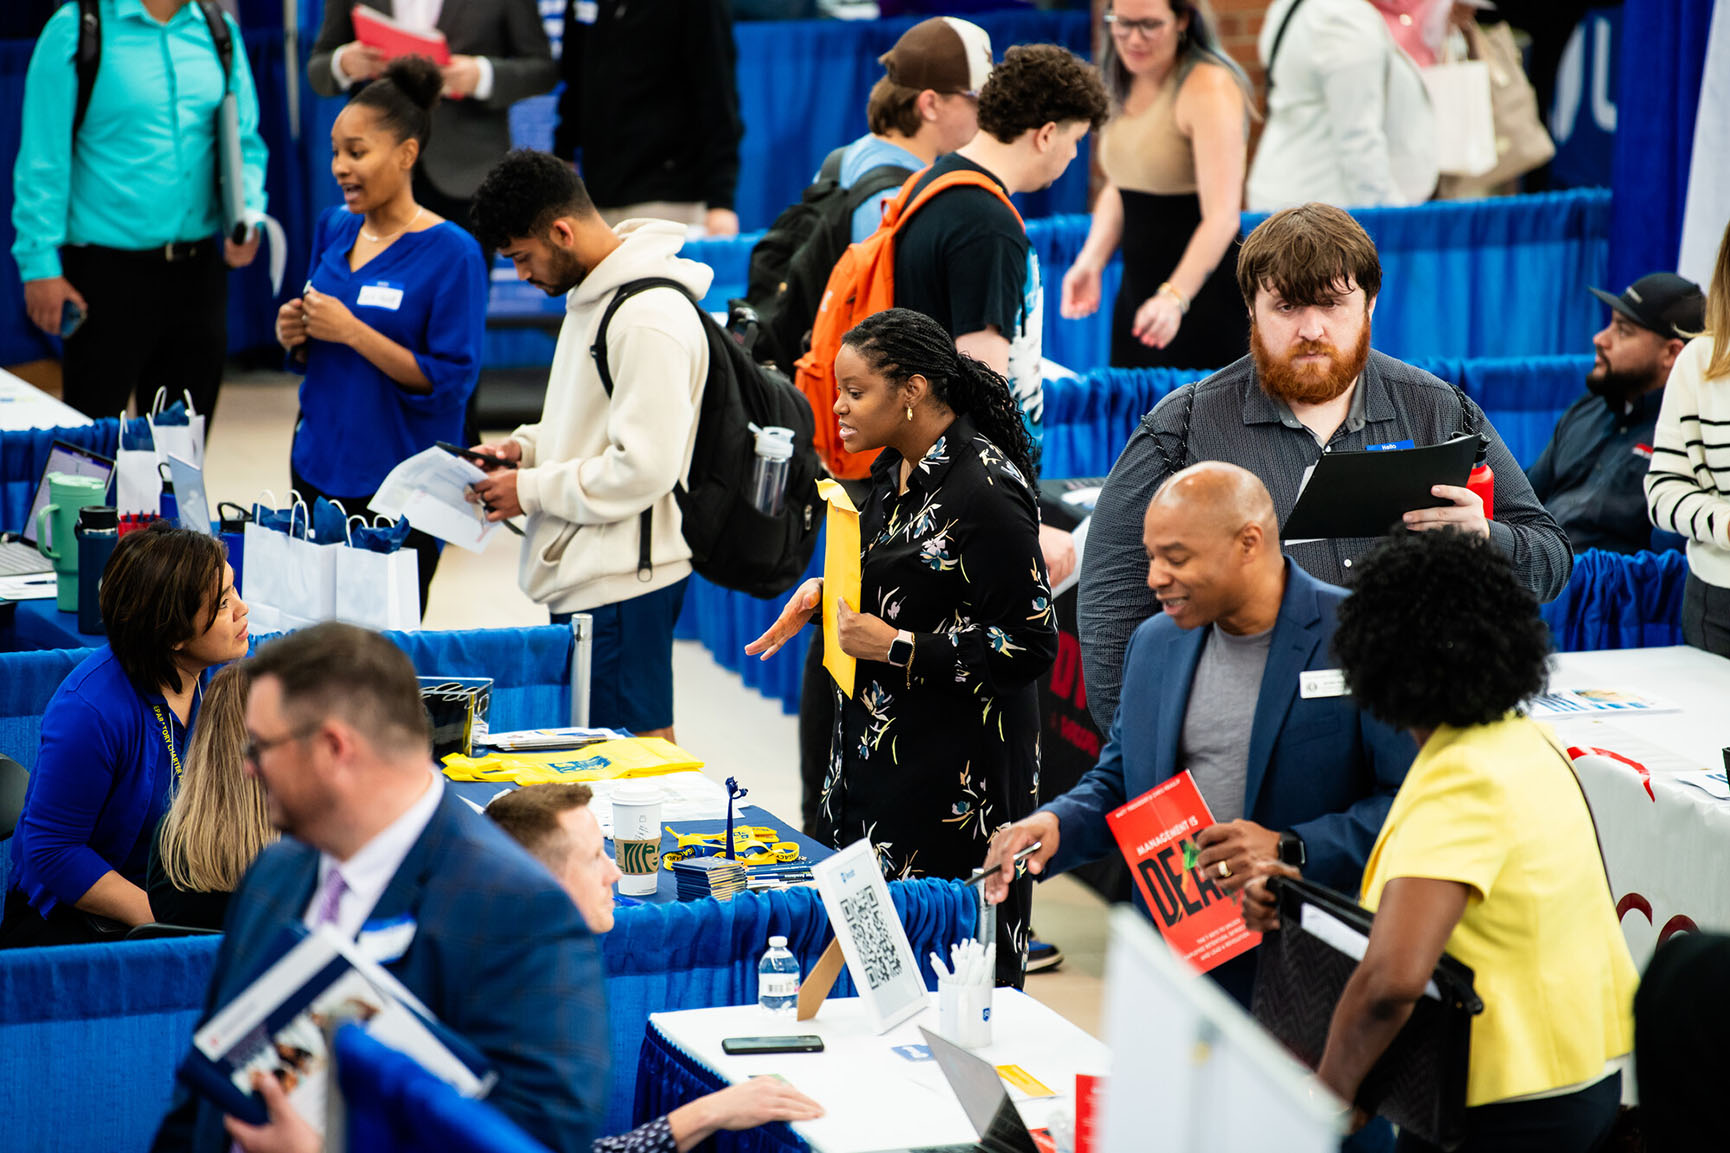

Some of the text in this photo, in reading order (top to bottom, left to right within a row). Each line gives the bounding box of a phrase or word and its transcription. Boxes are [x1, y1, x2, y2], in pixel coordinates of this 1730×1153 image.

[1136, 815, 1199, 856] MANAGEMENT IS
[1137, 828, 1230, 927] DEA
